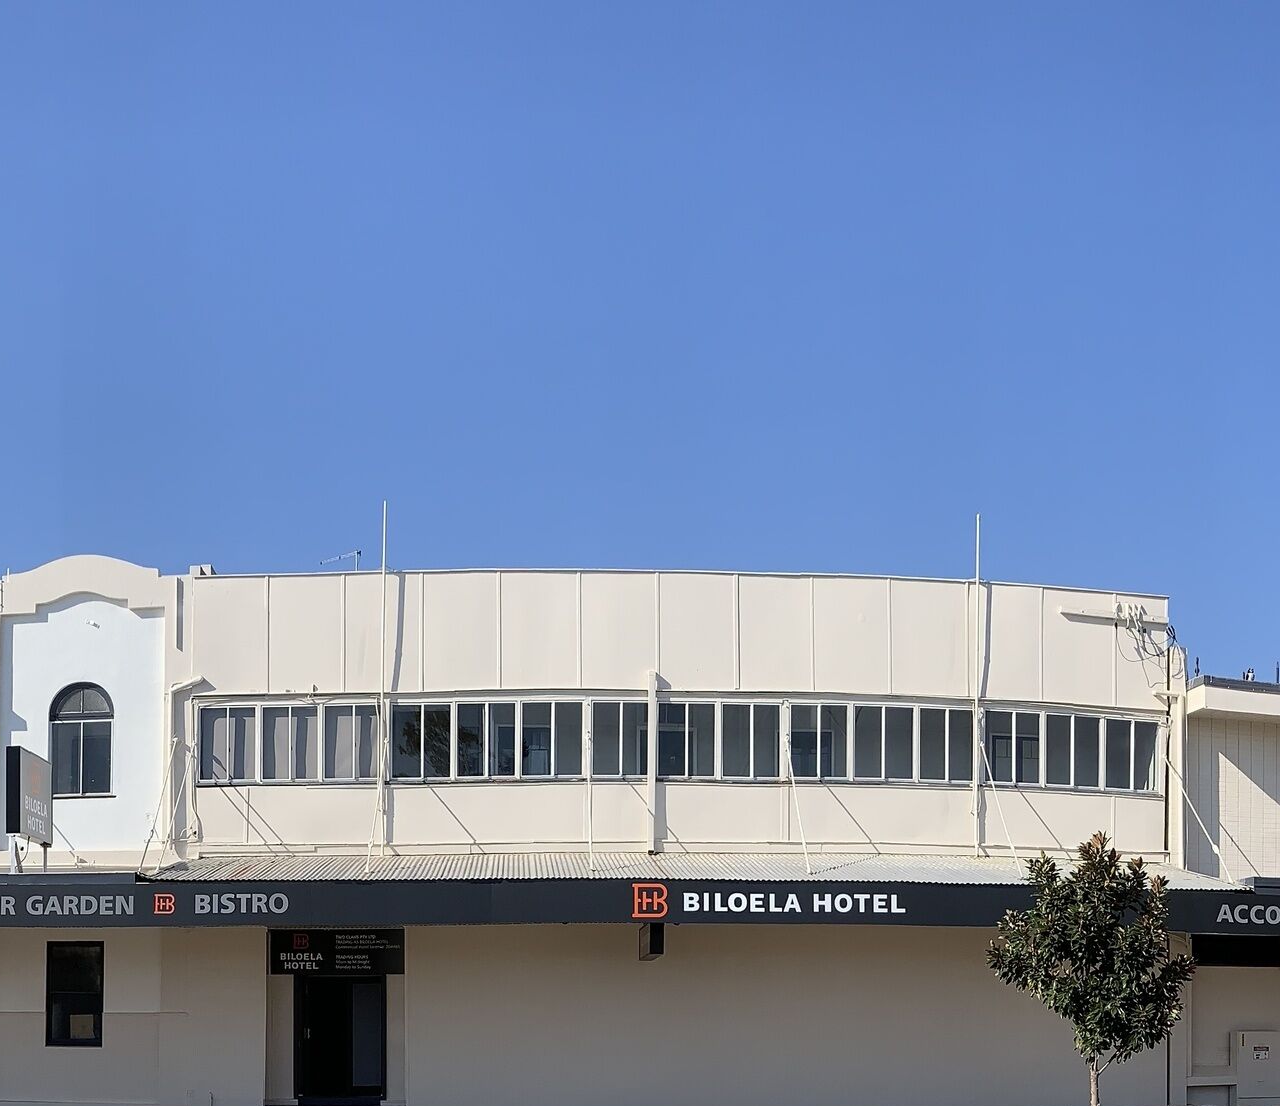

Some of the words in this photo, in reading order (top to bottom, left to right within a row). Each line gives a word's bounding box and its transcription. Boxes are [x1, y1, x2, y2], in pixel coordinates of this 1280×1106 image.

[24, 795, 48, 818] BILOELA
[27, 814, 46, 835] HOTEL
[25, 895, 134, 916] GARDEN
[194, 892, 289, 914] BISTRO
[683, 892, 802, 913] BILOELA
[813, 893, 907, 914] HOTEL
[280, 952, 323, 961] BILOELA
[284, 962, 320, 970] HOTEL
